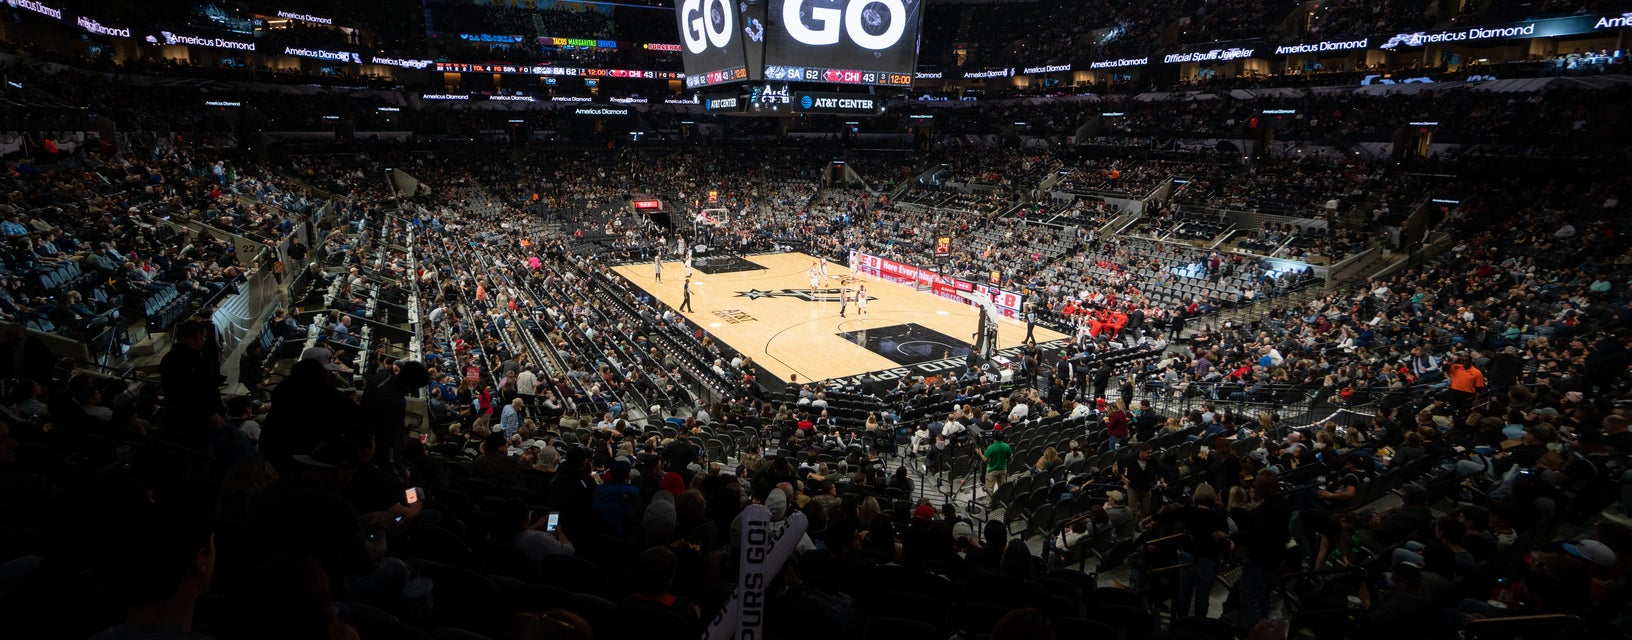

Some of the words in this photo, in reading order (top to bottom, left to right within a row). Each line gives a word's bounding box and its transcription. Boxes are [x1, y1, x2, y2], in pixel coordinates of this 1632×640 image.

[278, 10, 305, 21] Americus
[306, 14, 332, 25] Diamond
[682, 0, 732, 54] GO
[783, 0, 906, 50] GO
[1410, 31, 1467, 44] Americus
[1469, 23, 1535, 39] Diamond
[170, 33, 214, 47] Americus
[216, 38, 256, 51] Diamond
[553, 37, 567, 46] TACOS
[568, 39, 597, 47] MARGARITAS
[598, 40, 617, 48] CERVEZA
[1275, 43, 1318, 55] Americus
[1320, 38, 1368, 51] Diamond
[284, 46, 318, 58] Americus
[1164, 53, 1192, 64] Official
[1192, 51, 1217, 62] Spurs
[1218, 48, 1254, 60] Jeweler
[372, 56, 398, 66] Americus
[1090, 61, 1117, 69] Americus
[1118, 57, 1148, 67] Diamond
[588, 69, 606, 77] 12:00
[723, 71, 729, 80] 43
[1024, 67, 1046, 75] Americus
[1047, 64, 1071, 73] Diamond
[788, 69, 801, 79] SA
[806, 70, 819, 80] 62
[844, 72, 860, 82] CHI
[863, 74, 875, 83] 43
[890, 75, 912, 85] 12:00
[711, 99, 721, 109] AT&T
[721, 98, 737, 108] CENTER
[814, 98, 838, 108] AT&T
[838, 99, 874, 110] CENTER
[242, 245, 256, 253] 22
[937, 243, 949, 254] 24
[883, 260, 898, 273] Here
[899, 265, 940, 284] Everyhing's
[747, 521, 767, 564] GO!
